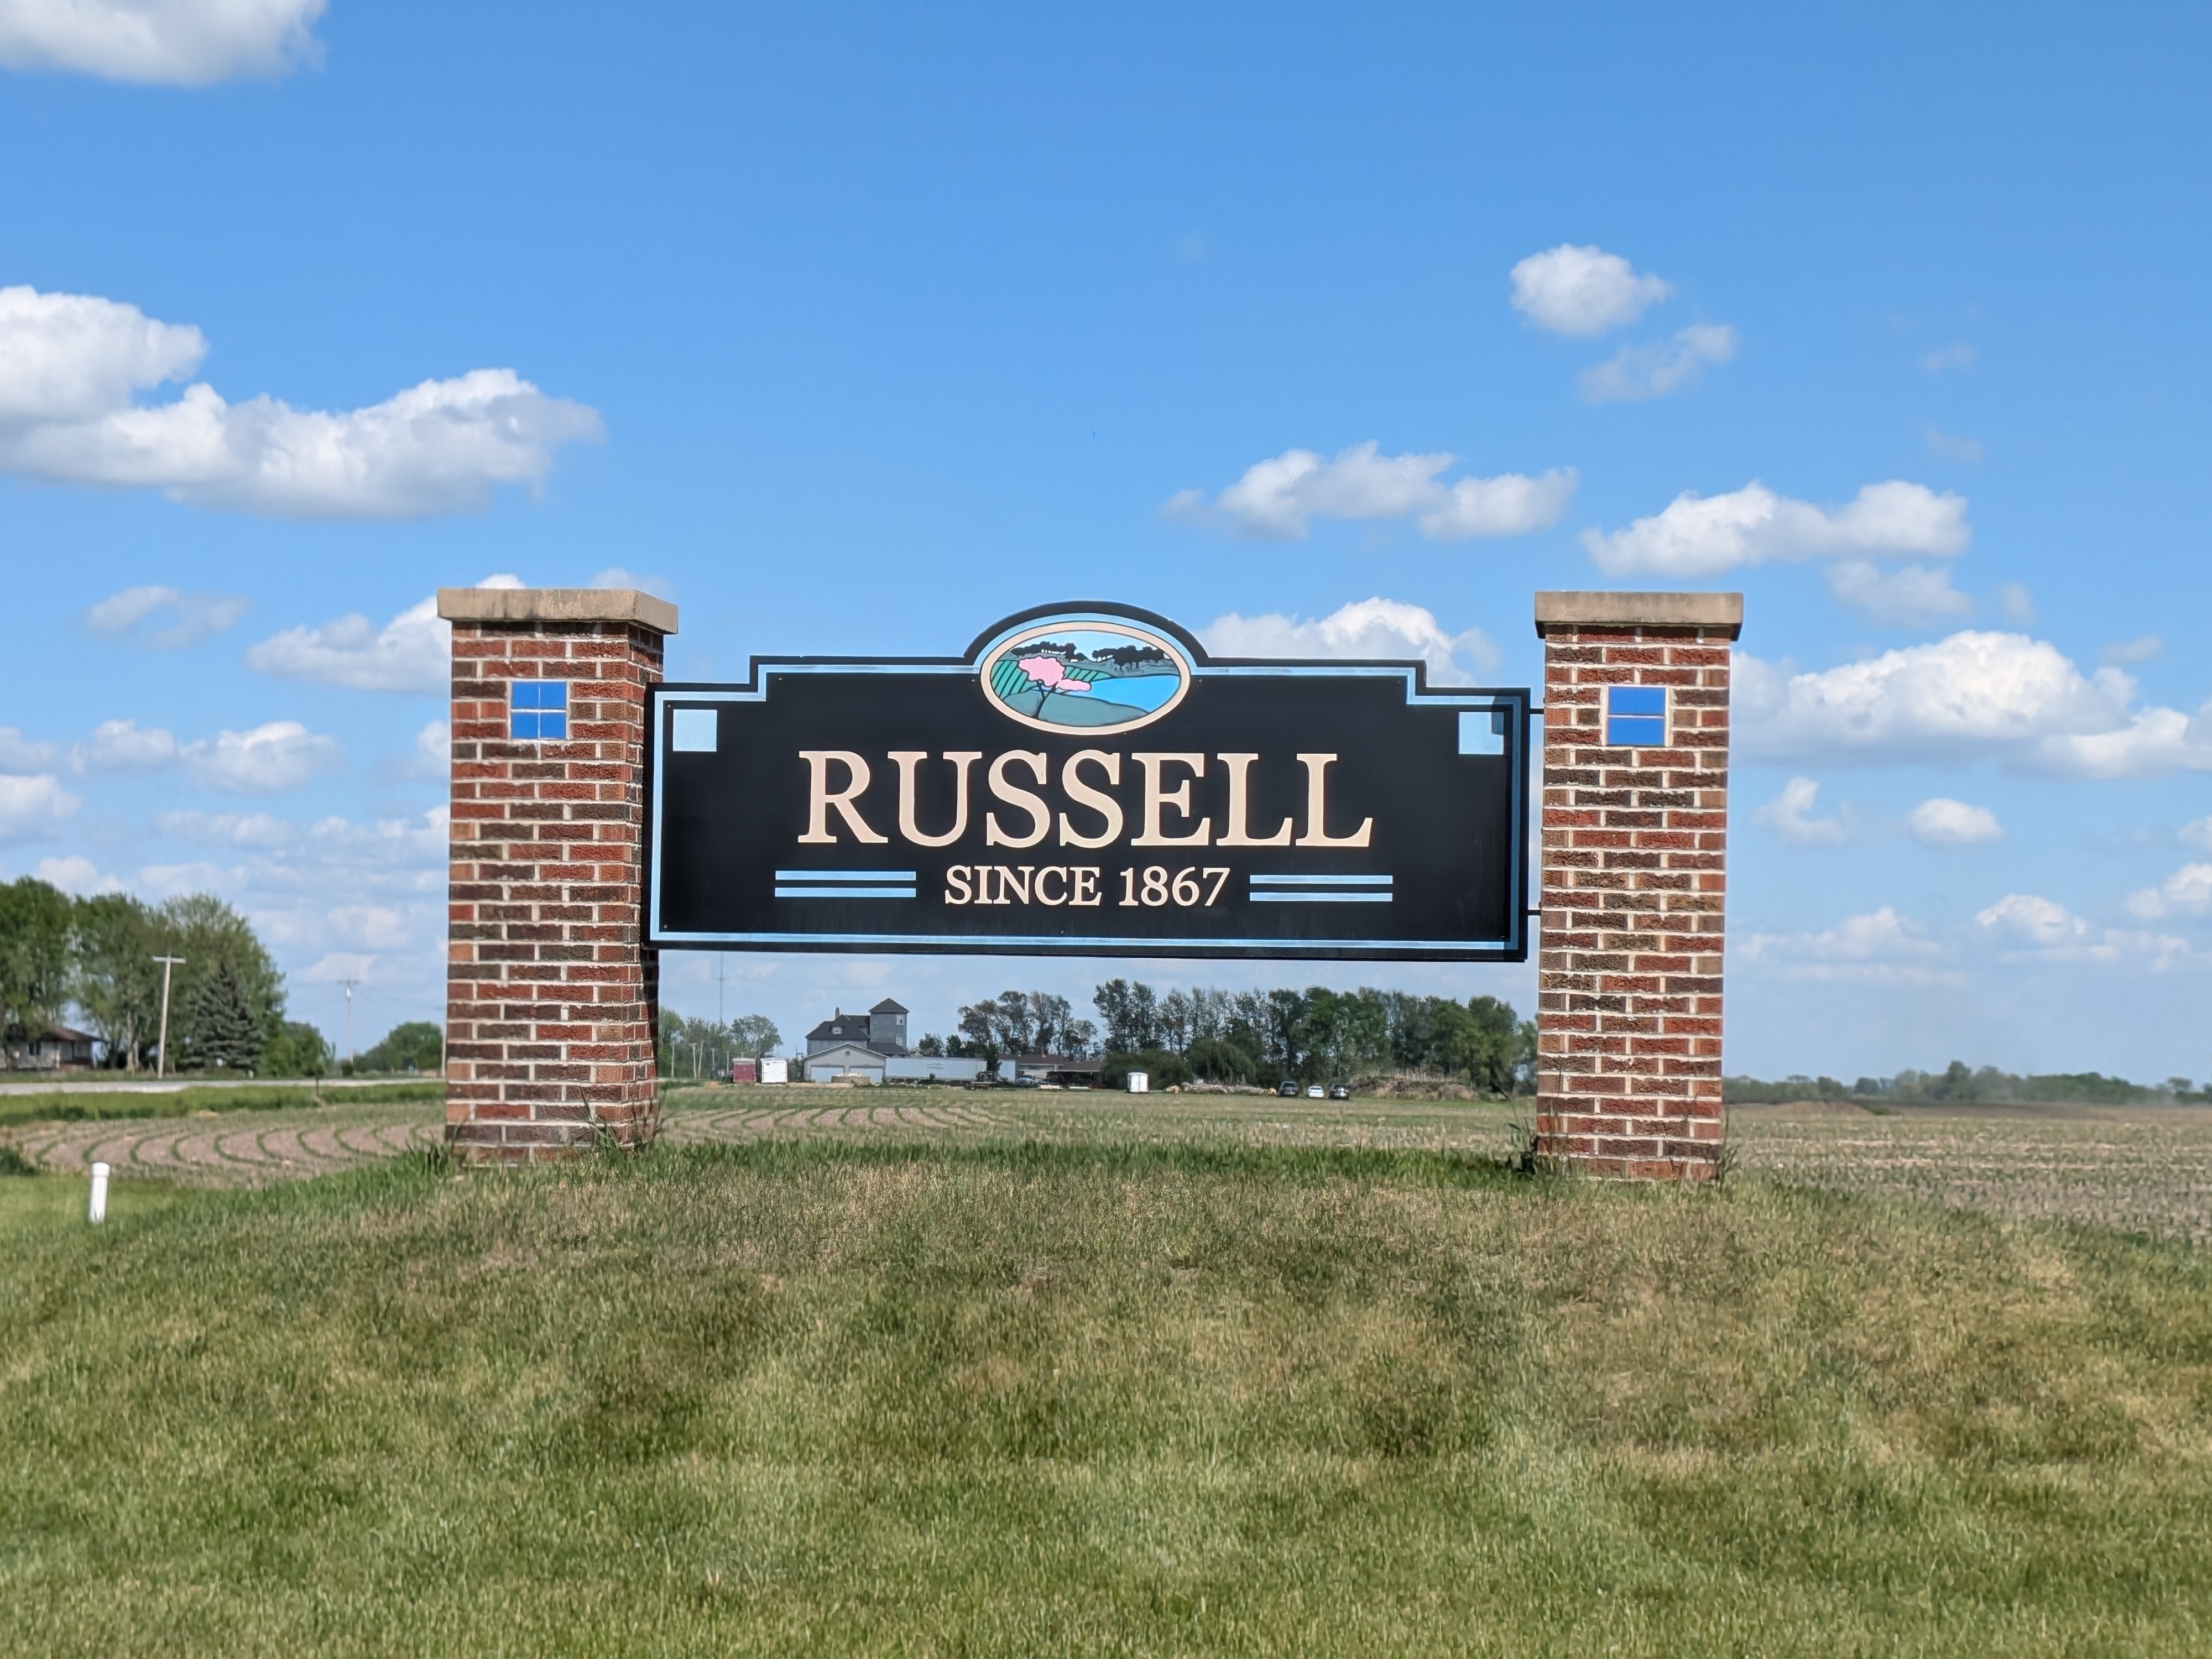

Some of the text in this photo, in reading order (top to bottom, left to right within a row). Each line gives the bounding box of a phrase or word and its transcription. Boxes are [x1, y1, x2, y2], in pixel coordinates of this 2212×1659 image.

[797, 749, 1373, 849] RUSSELL
[945, 865, 1230, 906] SINCE 1867
